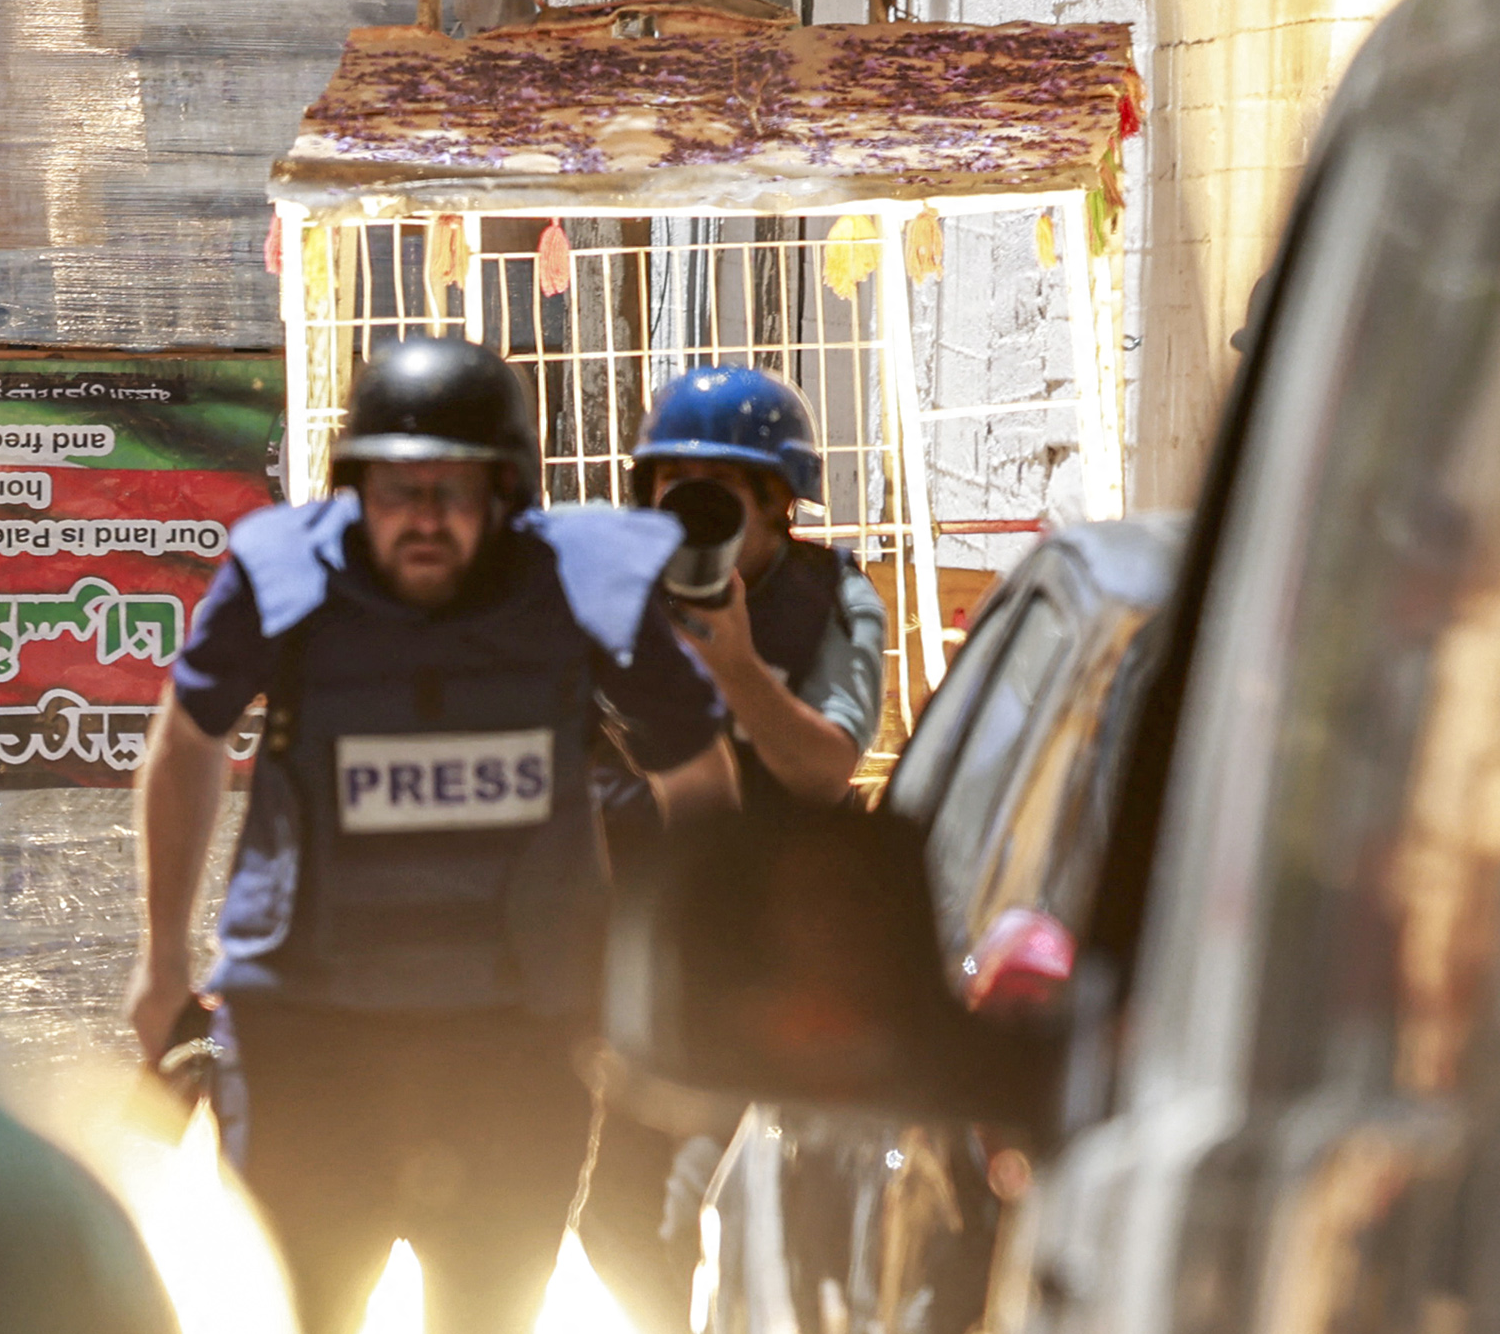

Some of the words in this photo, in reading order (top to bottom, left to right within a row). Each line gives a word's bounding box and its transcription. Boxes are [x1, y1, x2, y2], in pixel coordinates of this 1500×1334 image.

[51, 430, 107, 452] and
[63, 526, 85, 548] is
[94, 524, 157, 547] land
[166, 525, 221, 550] Our
[344, 752, 550, 810] PRESS
